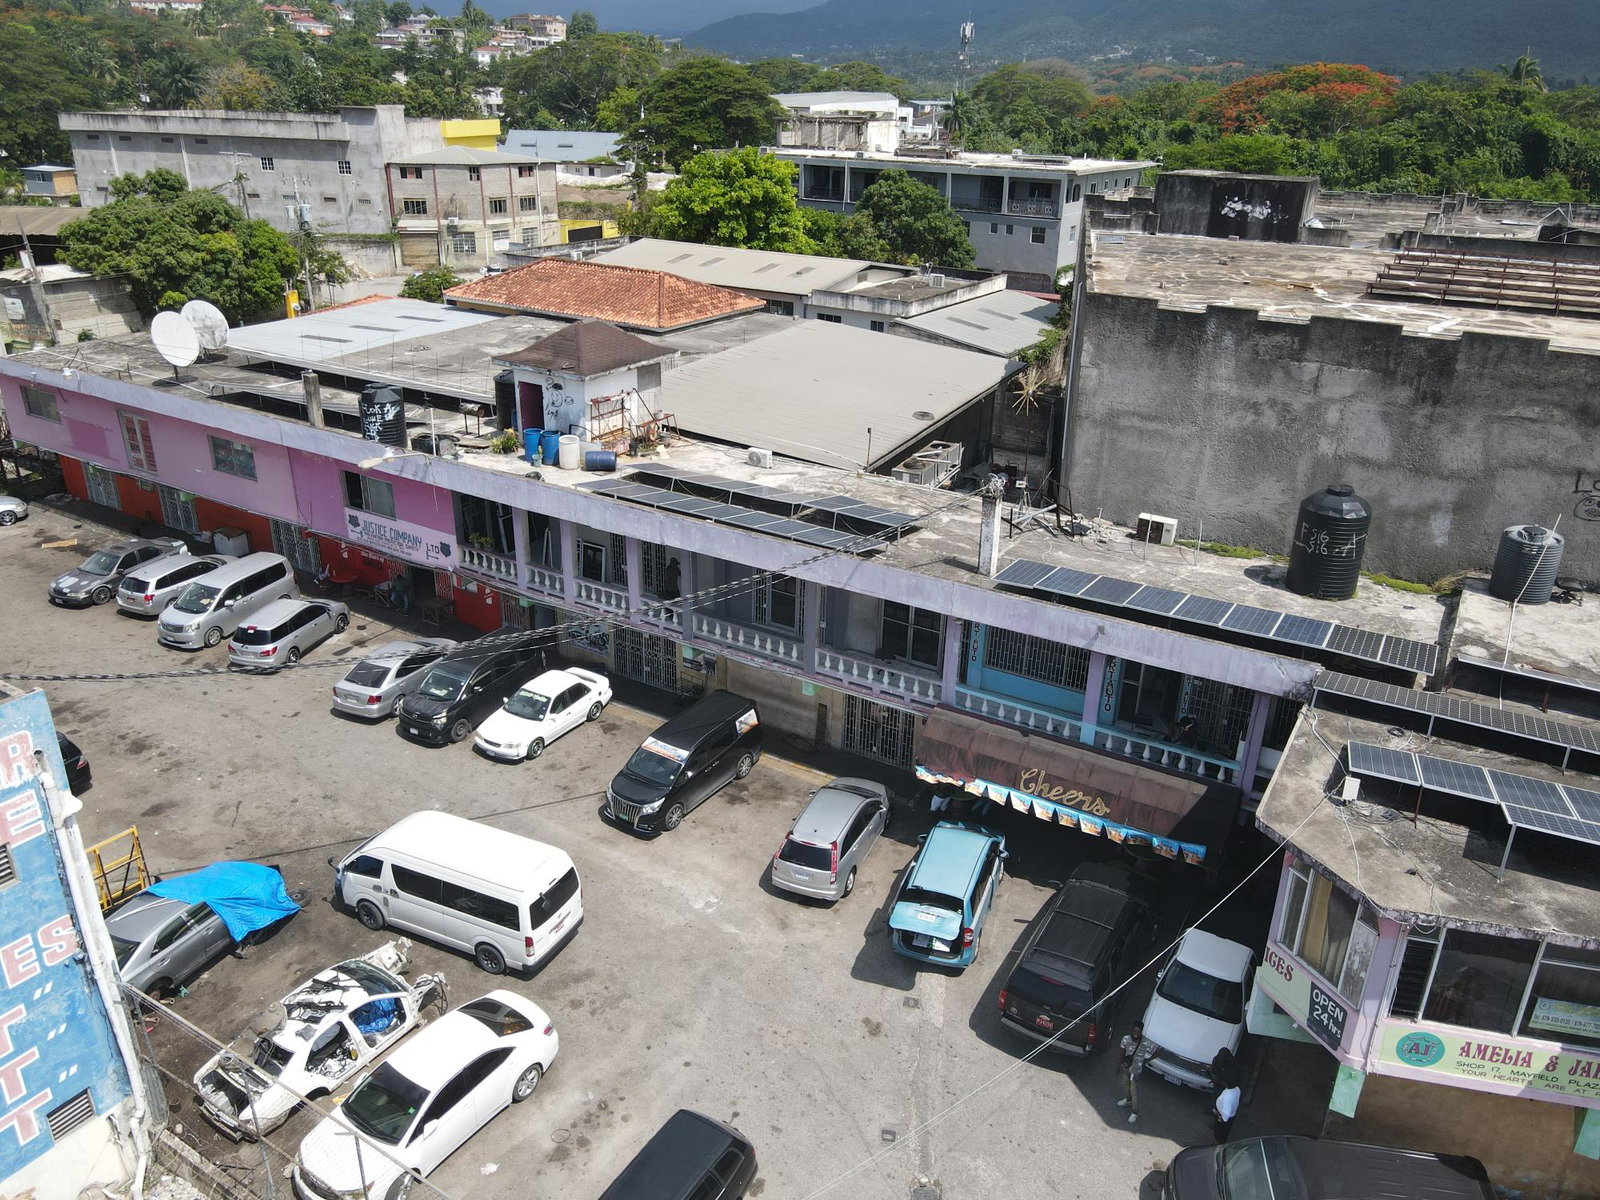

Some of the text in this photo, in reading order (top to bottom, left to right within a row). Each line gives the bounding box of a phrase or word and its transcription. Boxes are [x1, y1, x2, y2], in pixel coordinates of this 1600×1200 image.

[362, 520, 387, 537] JUSTICE
[389, 527, 422, 548] COMPANY
[426, 543, 439, 554] LTD
[1104, 679, 1114, 712] AUTO
[1020, 768, 1111, 816] Cheers
[1312, 989, 1344, 1022] OPEN
[1313, 1005, 1341, 1038] 24 hrs
[1458, 1041, 1534, 1068] AMELIA
[1544, 1055, 1560, 1072] &
[1456, 1061, 1486, 1069] SHOP
[1510, 1069, 1559, 1083] MAYFIELD
[1568, 1079, 1600, 1090] PLAZ
[1493, 1074, 1534, 1086] HEARTS
[1544, 1083, 1566, 1091] ARE
